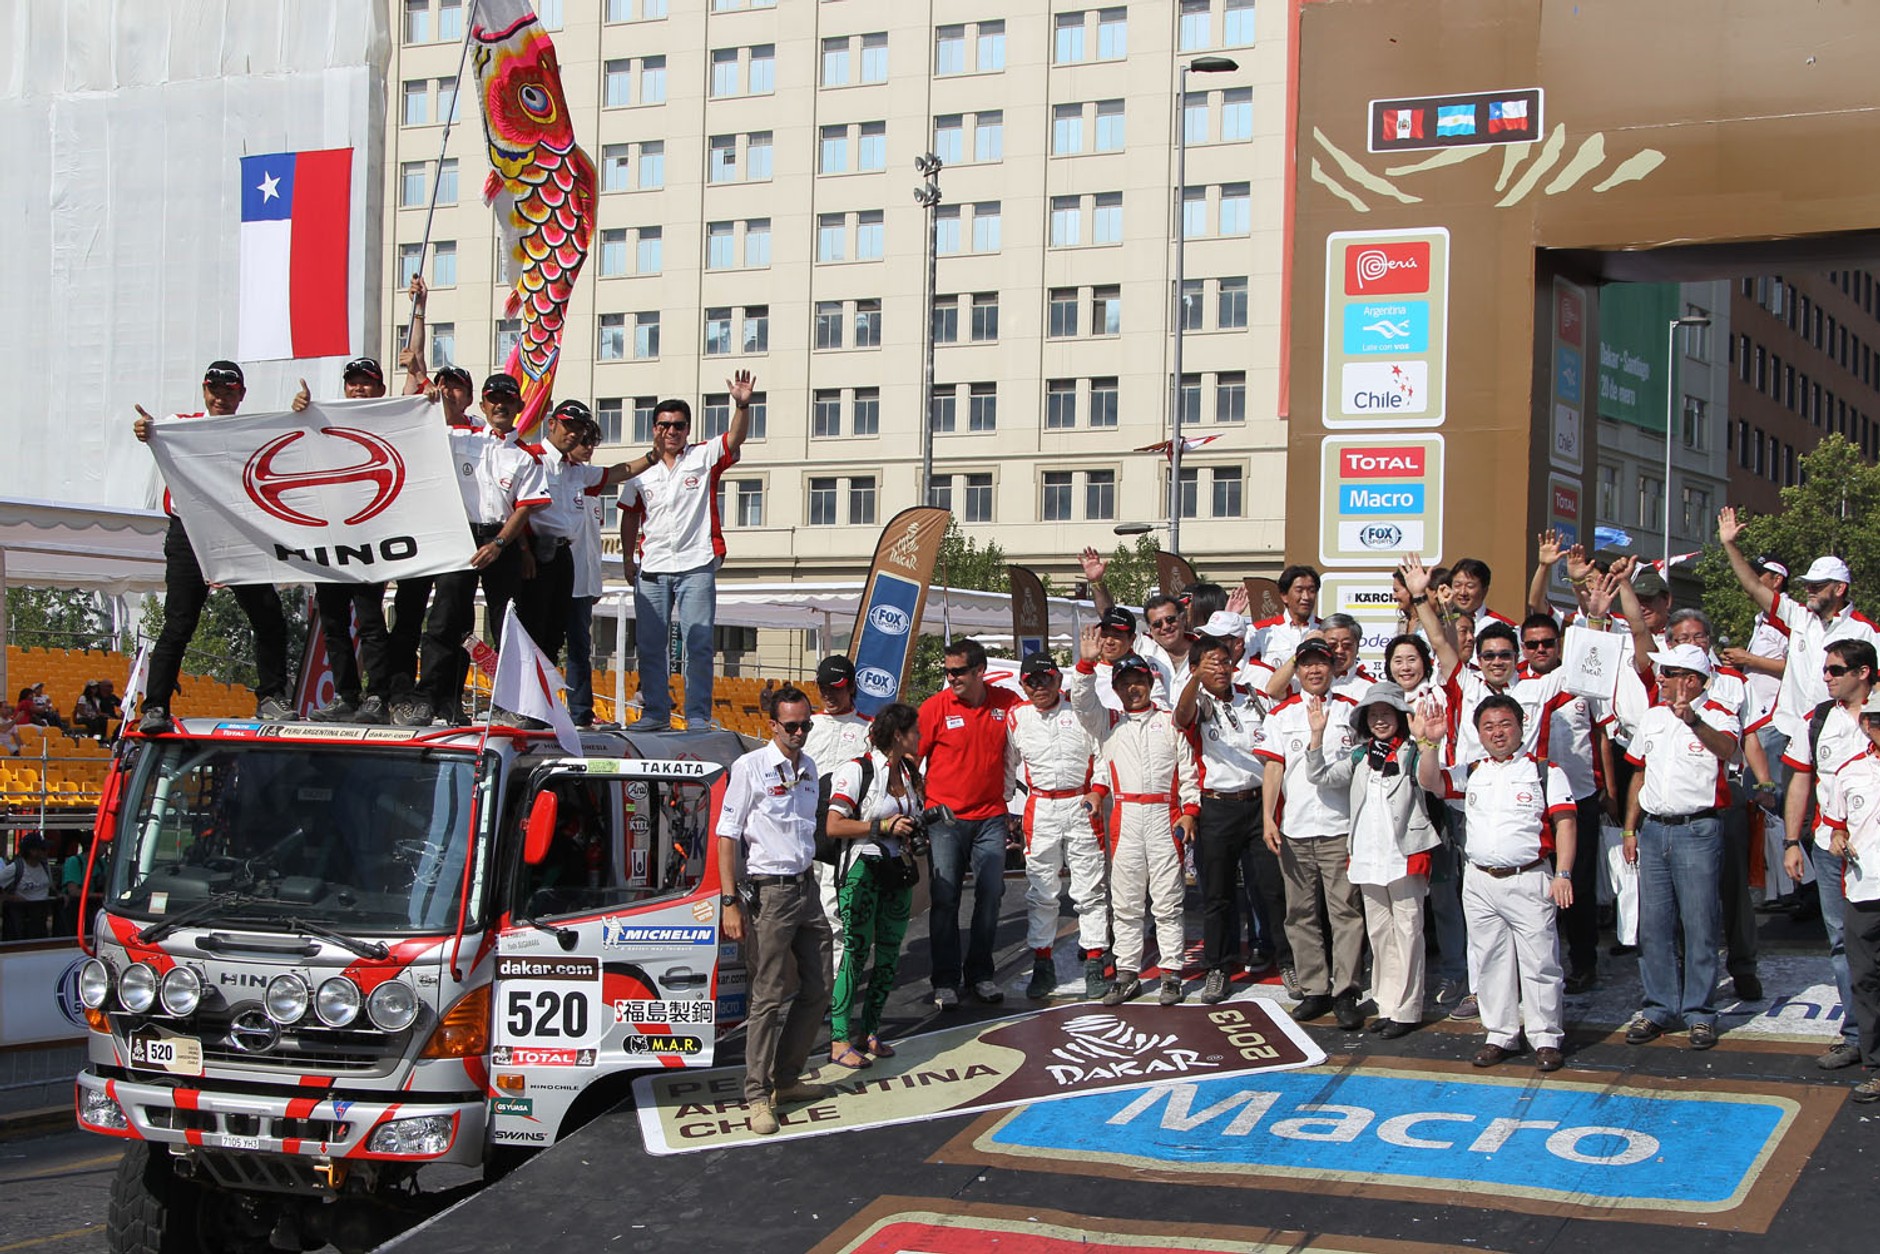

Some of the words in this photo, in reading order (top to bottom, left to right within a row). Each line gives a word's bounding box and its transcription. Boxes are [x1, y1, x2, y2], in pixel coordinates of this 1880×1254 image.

[1357, 250, 1418, 289] Perú
[1363, 305, 1407, 318] Argentina
[1354, 391, 1403, 409] Chile
[1346, 454, 1419, 470] TOTAL
[1350, 490, 1414, 507] Macro
[1368, 528, 1393, 539] FOX
[878, 609, 902, 627] FOX
[865, 671, 890, 689] FOX
[301, 728, 339, 737] ARGENTINA
[339, 730, 360, 738] CHILE
[368, 732, 412, 740] dakar.com
[641, 762, 704, 774] TAKATA
[624, 929, 712, 940] MICHELIN
[500, 960, 593, 976] dakar.com
[507, 991, 588, 1038] 520
[1208, 1009, 1280, 1060] 2013
[151, 1043, 173, 1061] 520
[652, 1038, 698, 1051] M.A.R.
[513, 1050, 574, 1063] TOTAL
[1045, 1049, 1219, 1085] DAKAR
[1106, 1083, 1661, 1166] Macro
[493, 1131, 546, 1141] SWANS
